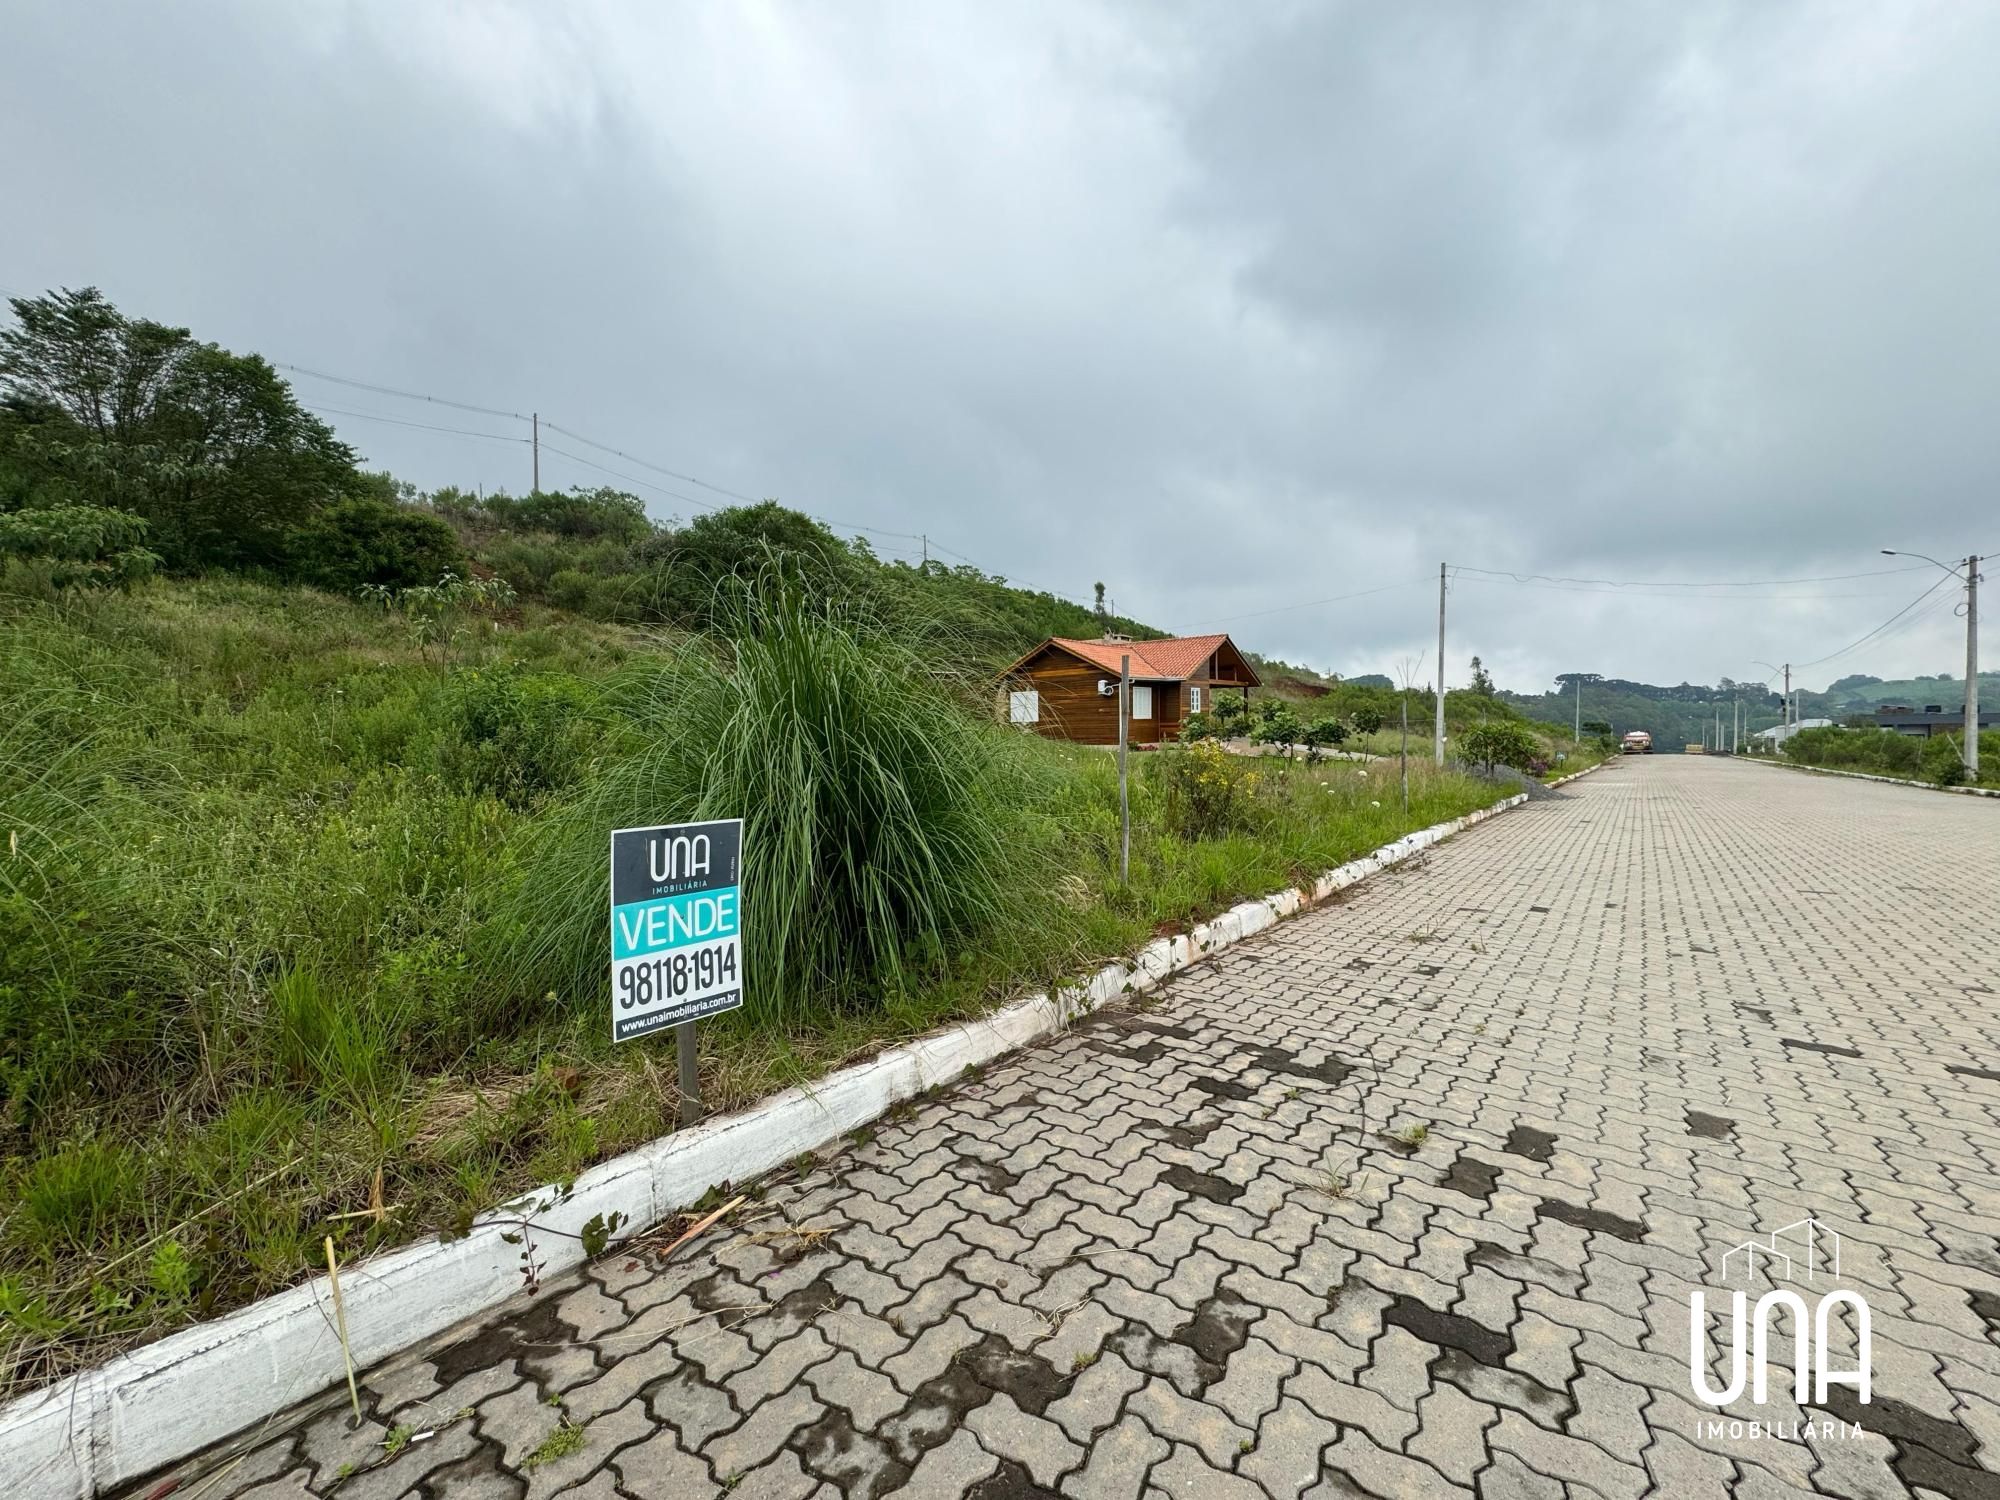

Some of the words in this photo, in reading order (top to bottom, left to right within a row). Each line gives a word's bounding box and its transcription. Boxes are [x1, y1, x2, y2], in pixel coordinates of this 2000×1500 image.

[650, 834, 711, 883] UNA
[652, 880, 708, 895] IMOBILIÁRIA
[619, 893, 734, 951] VENDE
[619, 942, 737, 1010] 98118-1914
[621, 993, 737, 1033] www.unaimobiliaria.com.br
